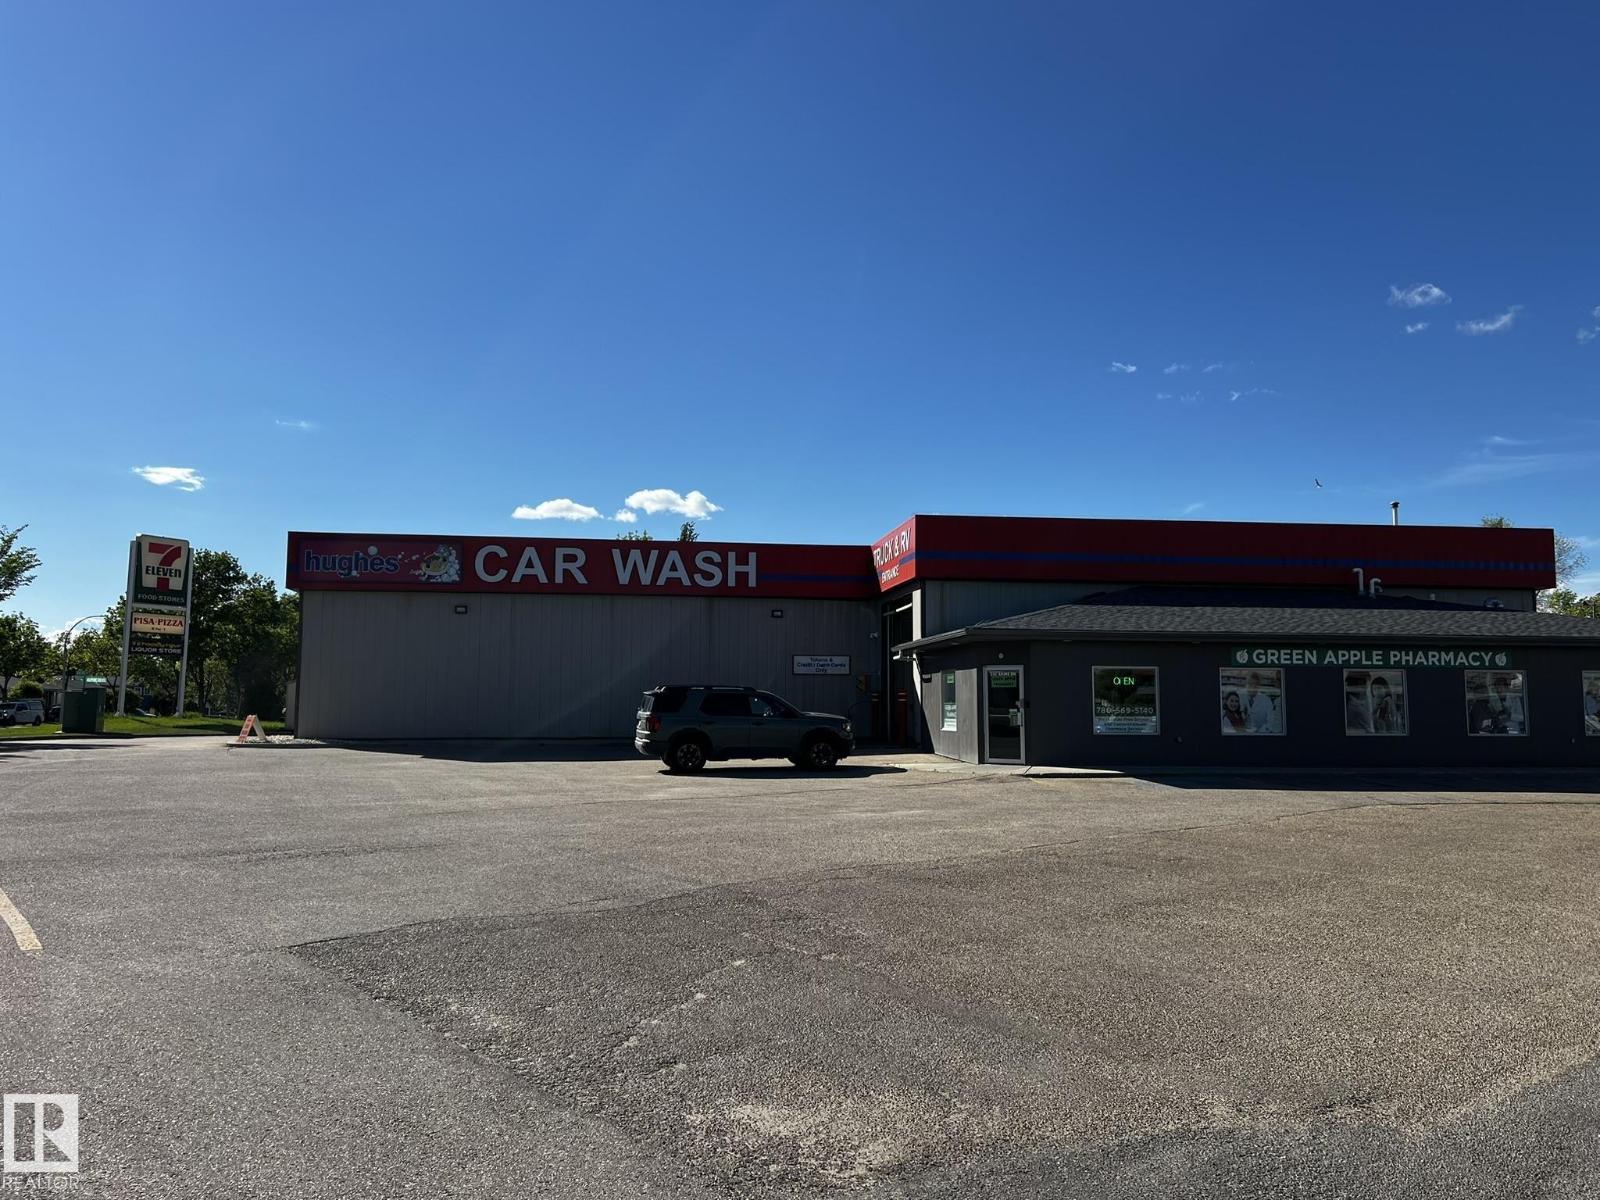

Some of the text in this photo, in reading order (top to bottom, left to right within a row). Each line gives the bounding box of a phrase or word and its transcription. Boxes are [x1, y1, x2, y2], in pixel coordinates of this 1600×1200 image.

[873, 528, 911, 568] TRUCK & RV
[146, 566, 182, 578] ELEVEN
[303, 549, 399, 577] hughes
[474, 544, 757, 588] CAR WASH
[881, 564, 899, 584] ENTRANCE
[158, 619, 183, 627] PIZZA
[1252, 650, 1492, 666] GREEN APPLE PHARMACY
